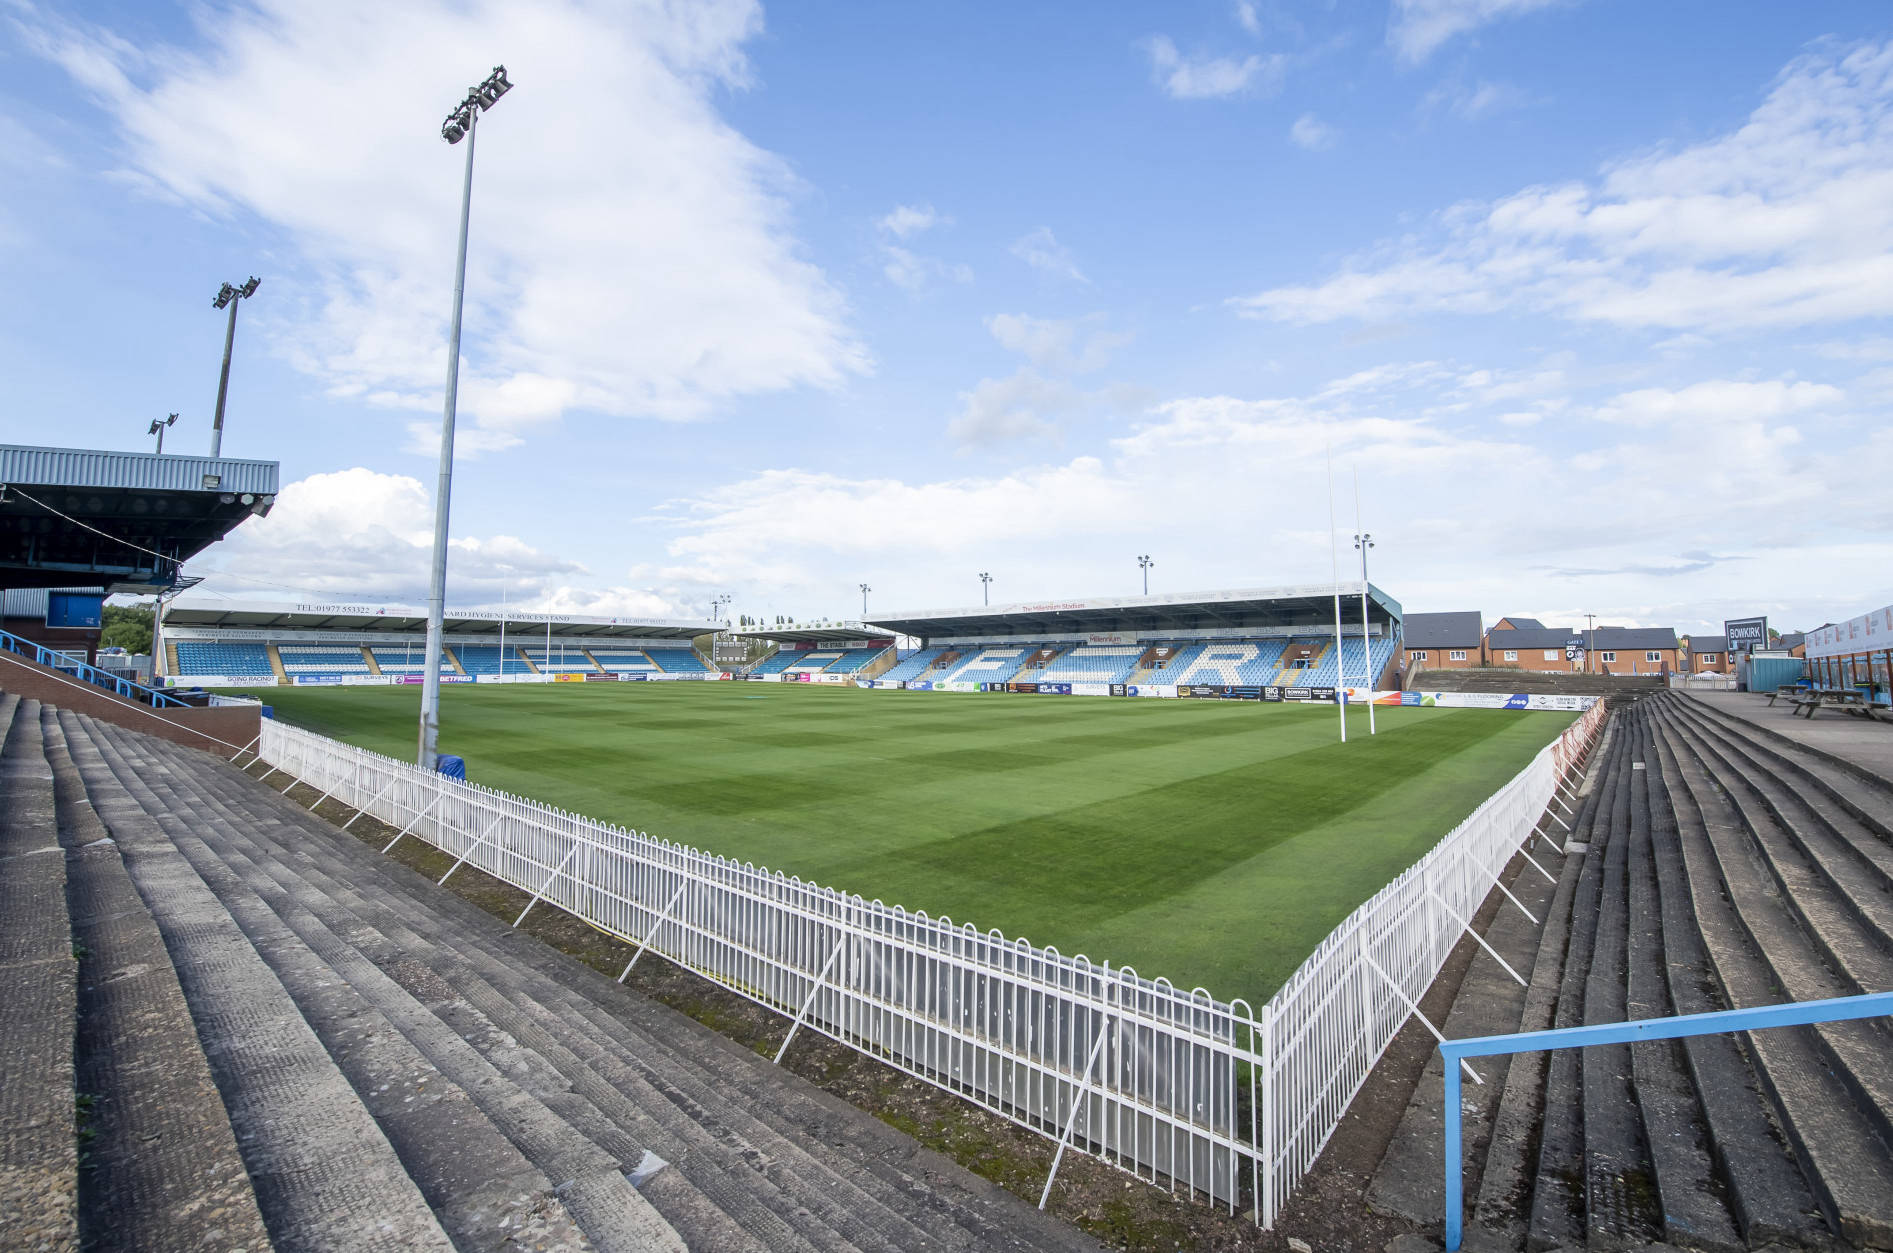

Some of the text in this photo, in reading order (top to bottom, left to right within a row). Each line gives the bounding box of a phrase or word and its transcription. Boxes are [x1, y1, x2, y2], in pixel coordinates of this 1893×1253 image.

[508, 613, 544, 621] SERVICES
[1730, 626, 1761, 639] BOWKIRK
[1089, 635, 1121, 643] Millennium
